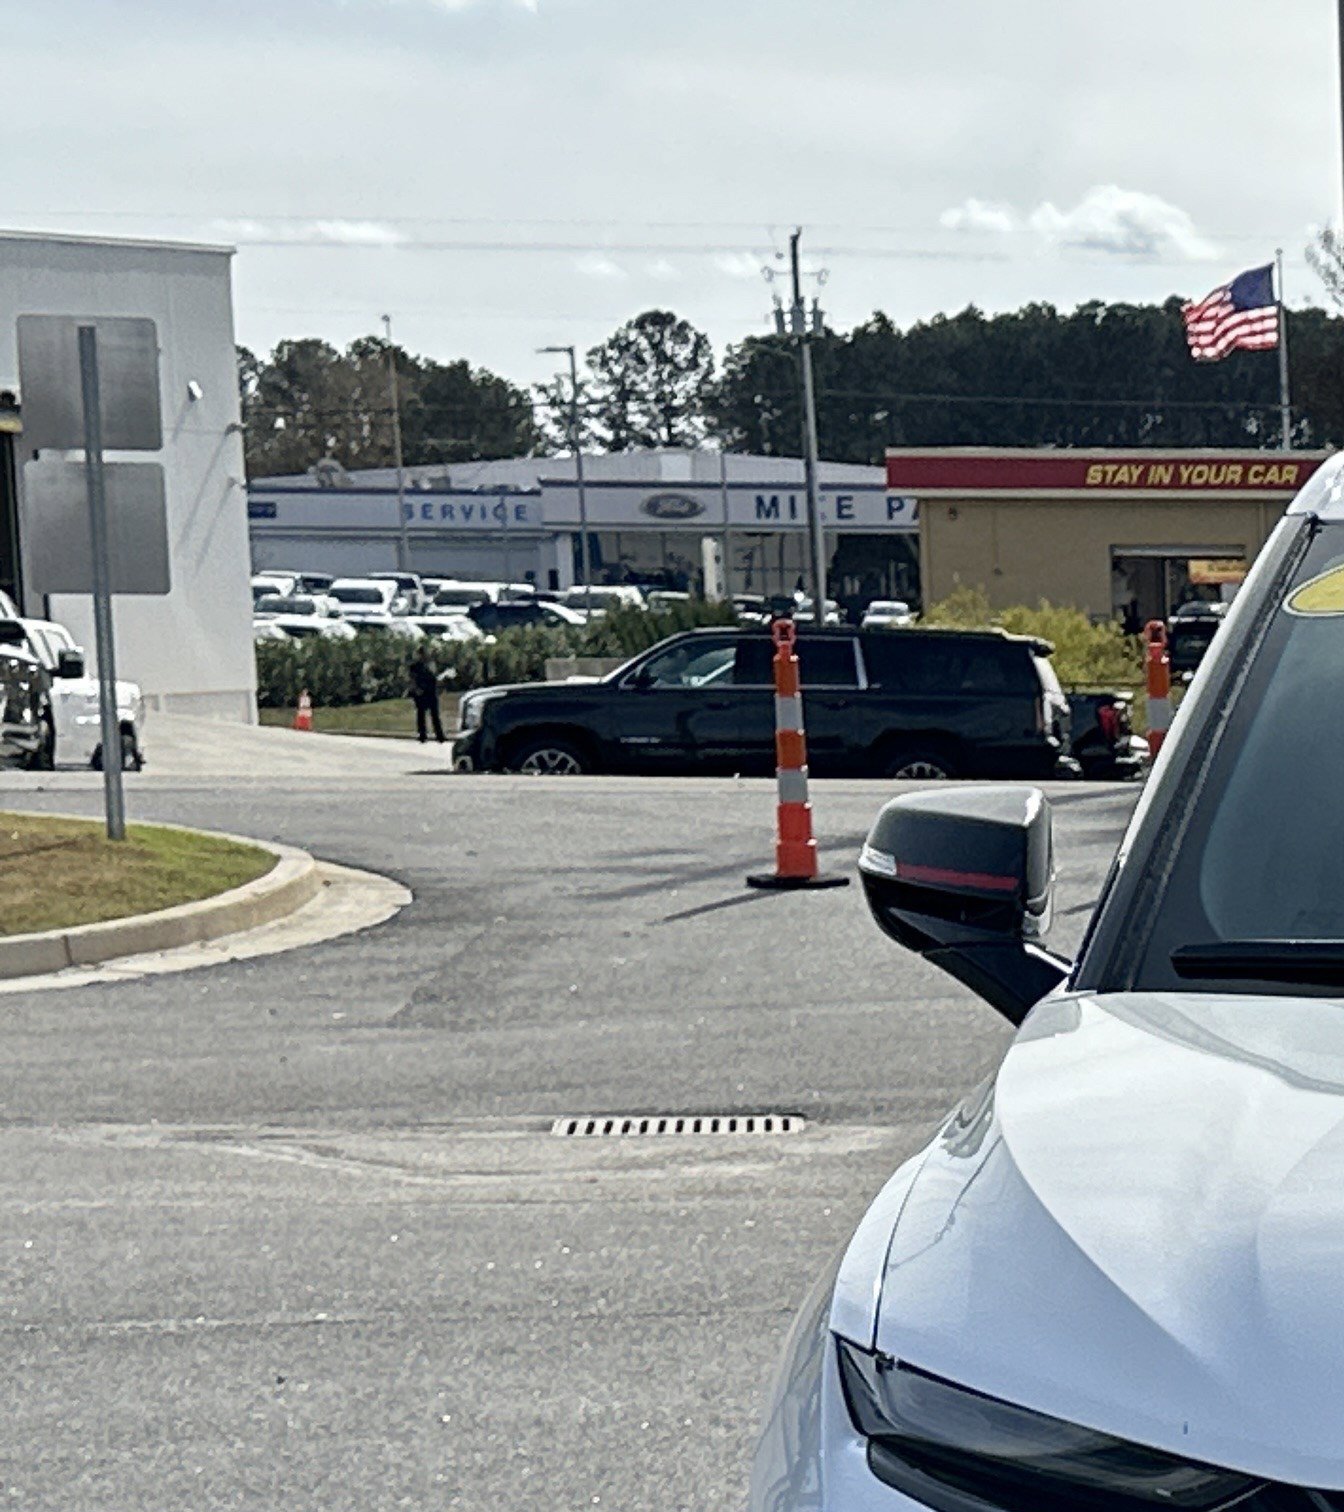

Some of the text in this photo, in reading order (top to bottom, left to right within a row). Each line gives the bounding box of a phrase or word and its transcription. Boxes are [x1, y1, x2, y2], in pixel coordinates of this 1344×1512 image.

[1086, 464, 1298, 485] STAY IN YOUR CAR
[402, 502, 527, 521] SERVICE
[754, 495, 855, 520] MIE
